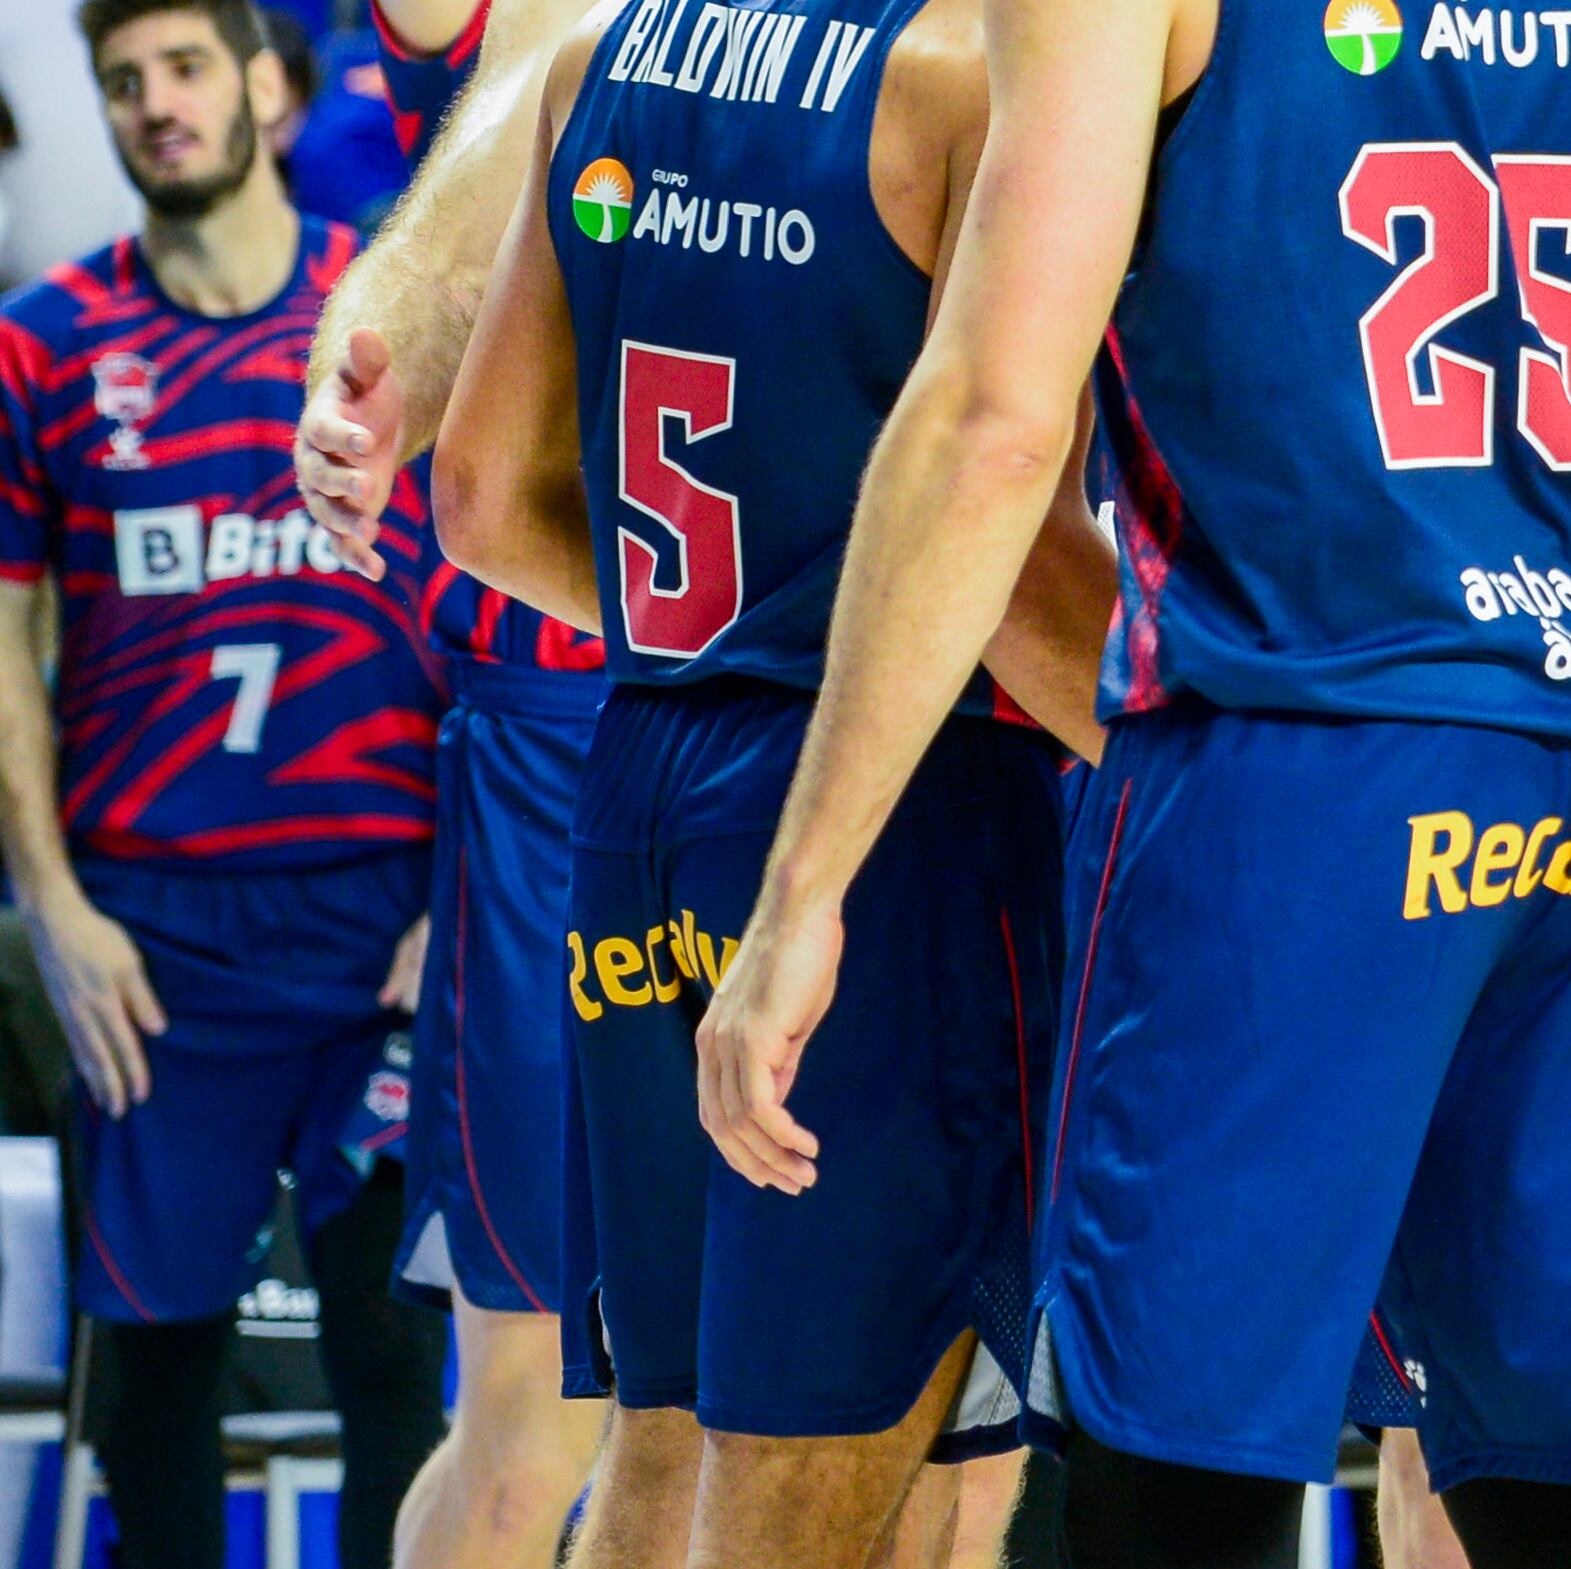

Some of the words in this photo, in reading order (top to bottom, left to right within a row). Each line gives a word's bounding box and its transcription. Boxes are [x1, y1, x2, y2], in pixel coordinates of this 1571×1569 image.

[799, 20, 877, 113] IV
[633, 188, 816, 265] AMUTIO
[206, 508, 362, 581] Bitc
[618, 339, 743, 659] 5
[210, 643, 282, 753] 7
